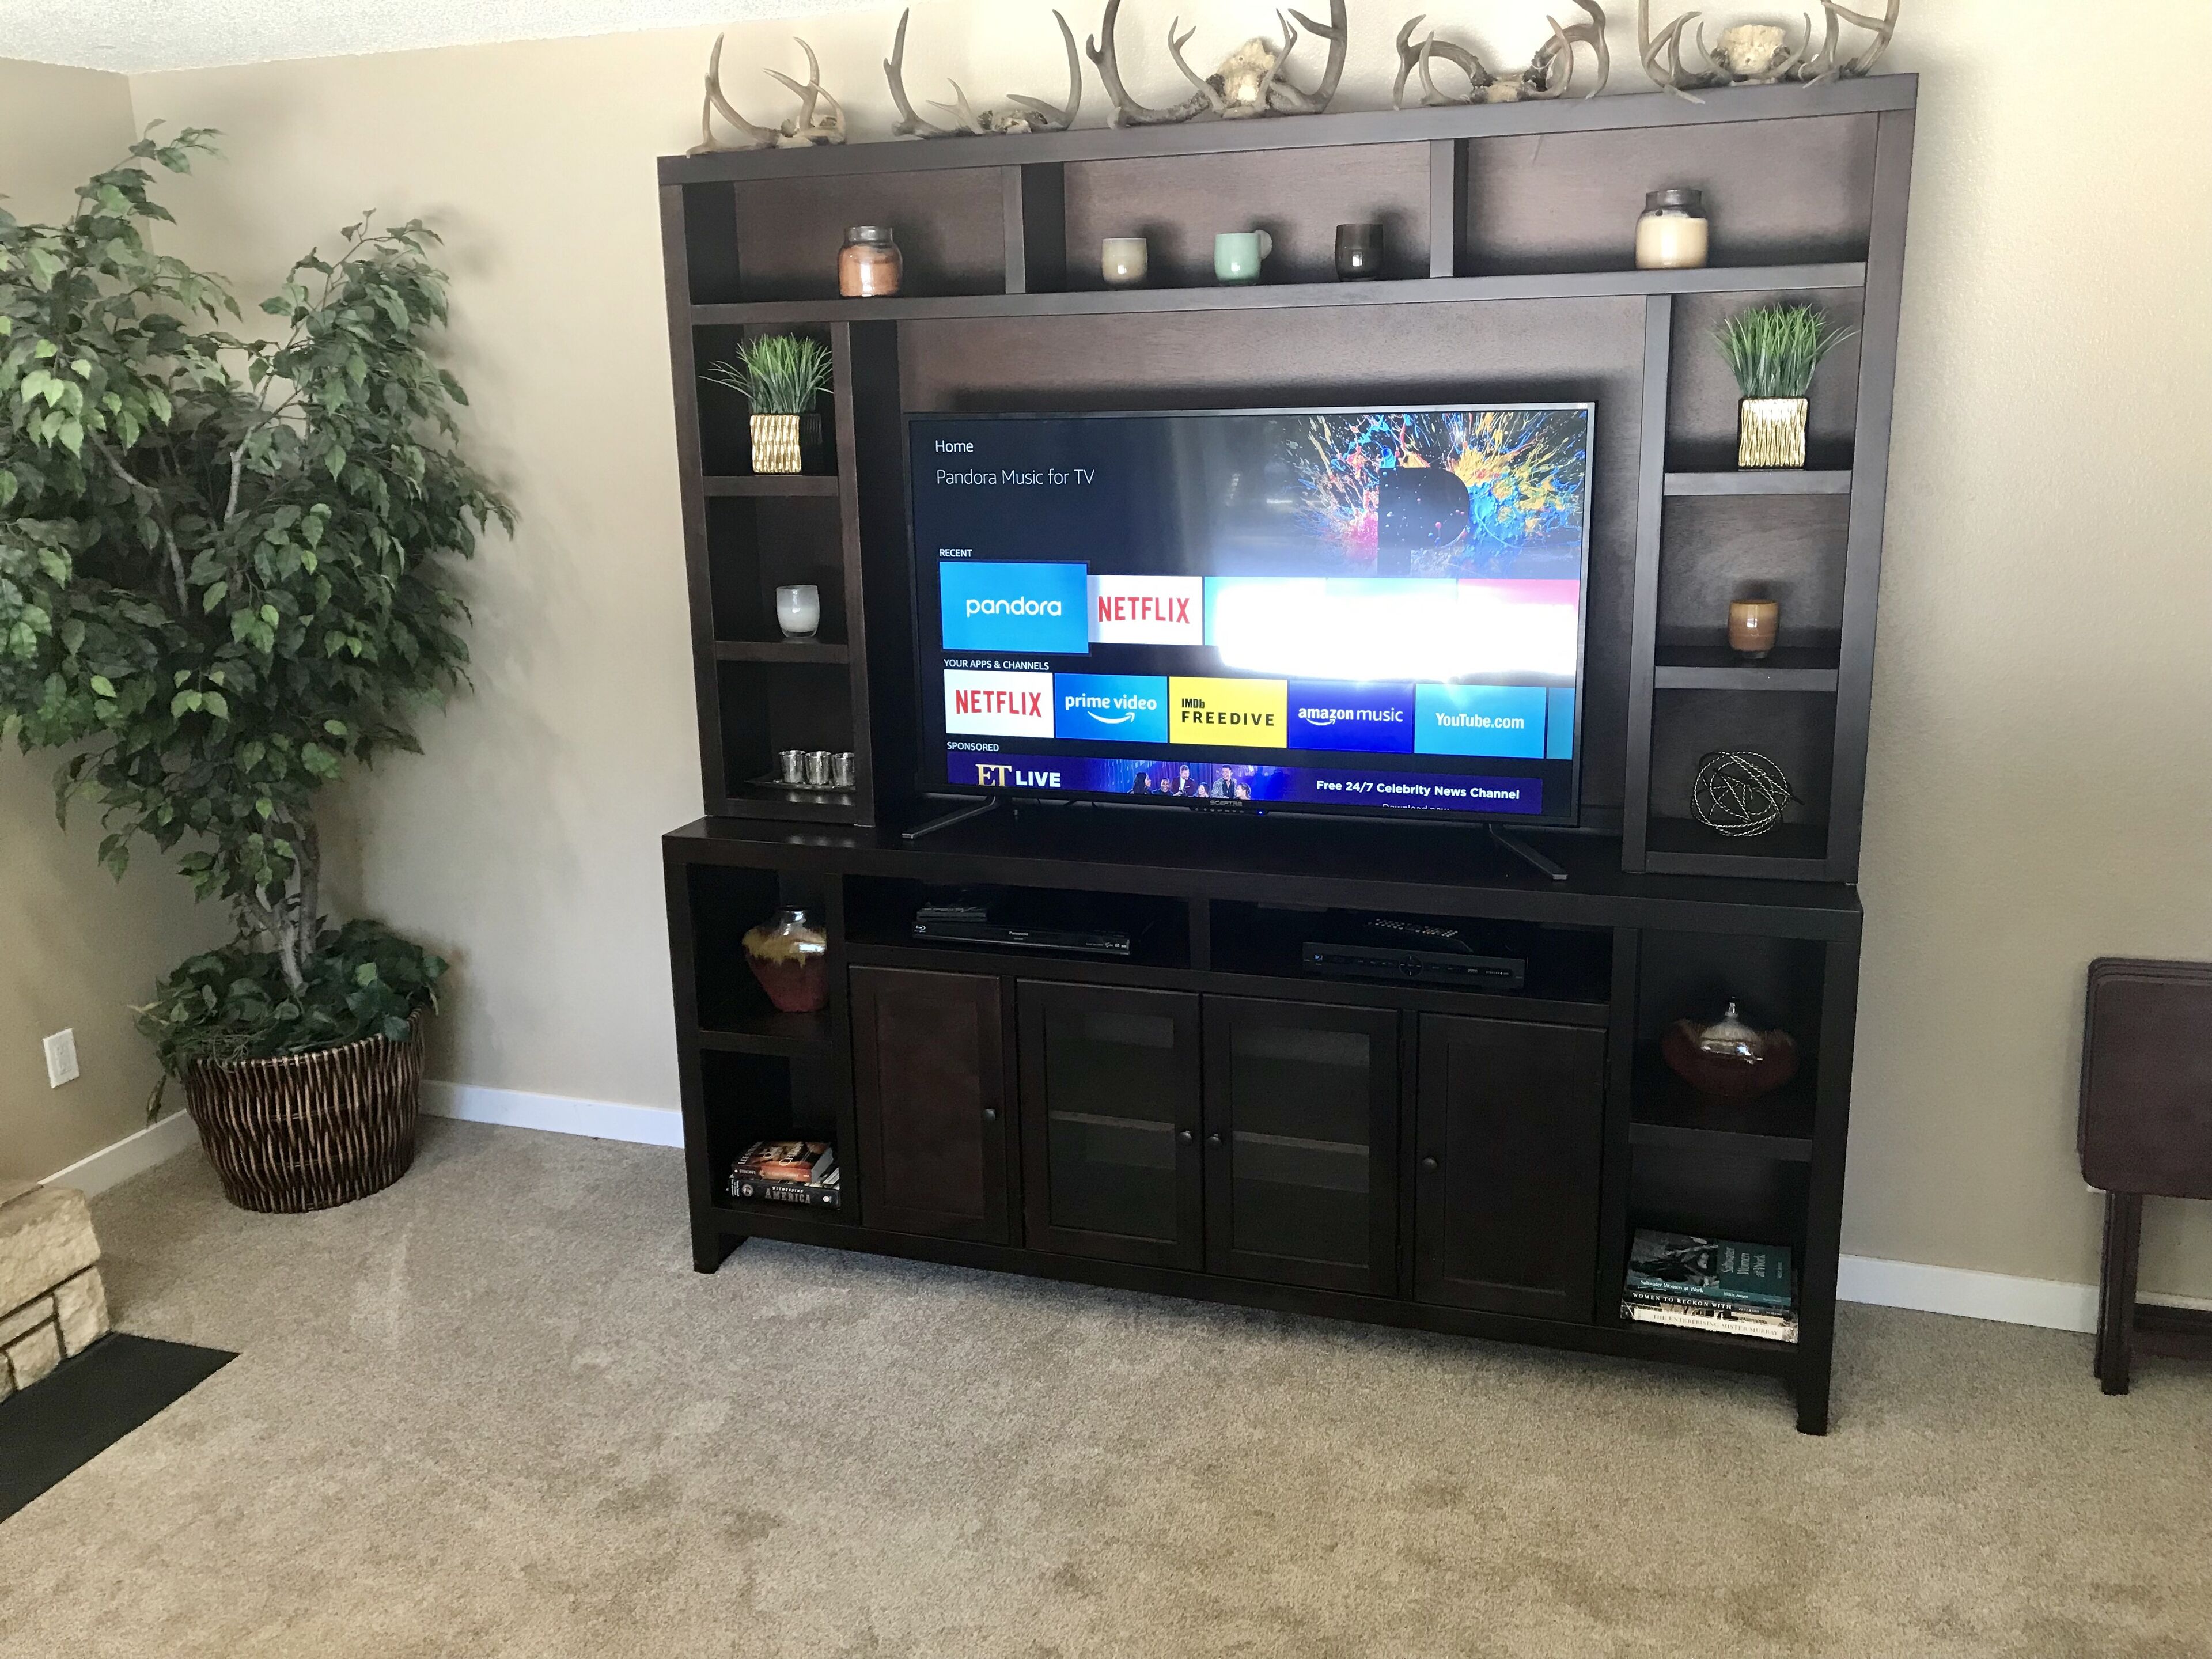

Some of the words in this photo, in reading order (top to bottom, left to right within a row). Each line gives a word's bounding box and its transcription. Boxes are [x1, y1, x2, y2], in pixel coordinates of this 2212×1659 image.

[935, 440, 974, 453] Home
[936, 469, 997, 485] Pandora
[1002, 468, 1043, 485] Music
[1047, 468, 1070, 485] for
[1074, 468, 1095, 484] TV
[939, 548, 972, 558] RECENT
[966, 596, 1062, 618] pandora
[1098, 596, 1190, 624] NETFLIX
[944, 659, 968, 668] YOUR
[969, 660, 991, 669] APPS
[993, 661, 1001, 669] &
[1003, 660, 1050, 671] CHANNELS
[955, 689, 1042, 718] NETFLIX
[1065, 693, 1111, 710] prime
[1113, 695, 1157, 711] video
[1181, 698, 1205, 709] IMDb
[1181, 711, 1274, 726] FREEDIVE
[1298, 707, 1354, 721] amazon
[1357, 707, 1403, 722] music
[1435, 712, 1525, 730] YouTube.com
[946, 741, 999, 752] SPONSORED
[975, 763, 1012, 787] ET
[1016, 770, 1061, 787] LIVE
[1316, 780, 1342, 791] Free
[1346, 781, 1374, 794] 24/7
[1377, 783, 1431, 797] Celebrity
[1434, 786, 1467, 798] News
[1470, 787, 1520, 800] Channel
[764, 1188, 811, 1204] AMERICA
[1633, 1292, 1660, 1301] WOMEN
[1677, 1298, 1709, 1308] RECKON
[1669, 1314, 1718, 1328] ENTERPRISING
[1721, 1322, 1749, 1332] MISTER
[1749, 1325, 1778, 1336] MURRAY
